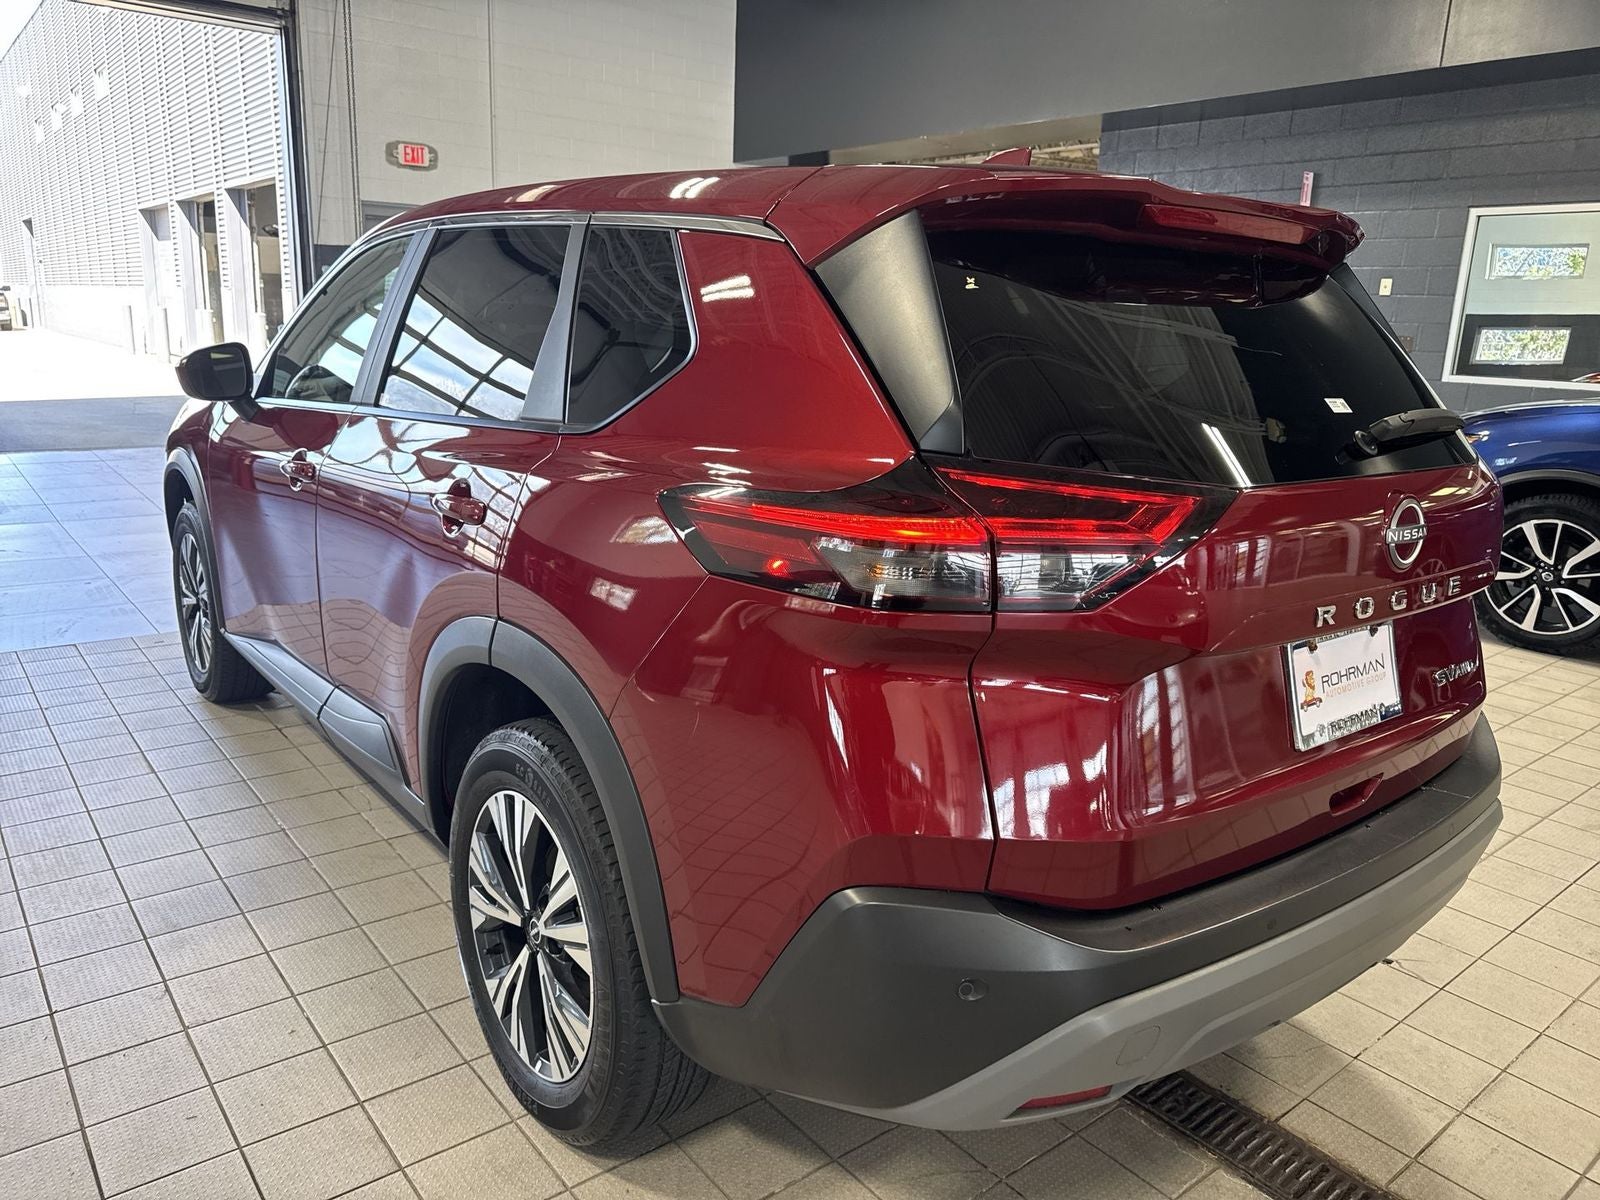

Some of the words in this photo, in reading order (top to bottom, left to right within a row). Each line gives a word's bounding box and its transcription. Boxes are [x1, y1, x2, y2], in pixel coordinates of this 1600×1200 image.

[403, 145, 425, 164] EXIT
[1316, 575, 1462, 628] ROGUE
[1321, 653, 1386, 694] ROHRMAN
[1325, 681, 1365, 698] AUTOMOTIVE
[1366, 671, 1387, 685] GROUP
